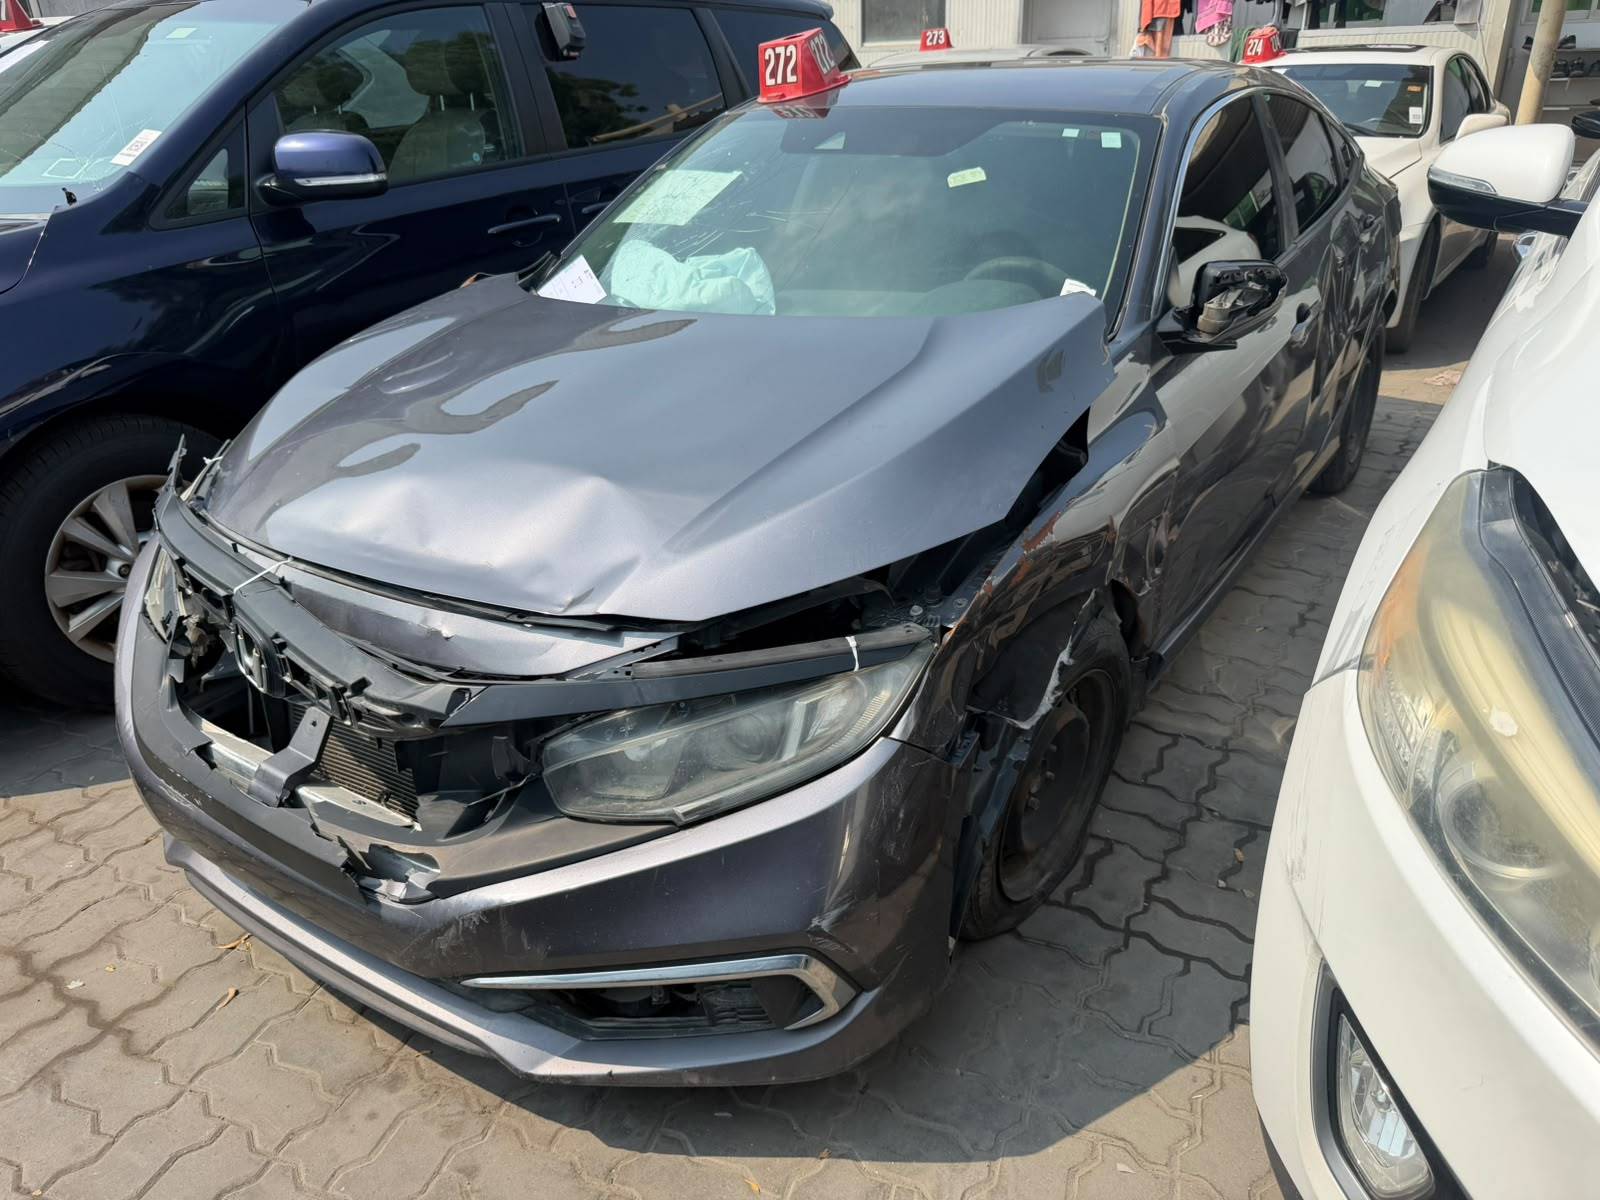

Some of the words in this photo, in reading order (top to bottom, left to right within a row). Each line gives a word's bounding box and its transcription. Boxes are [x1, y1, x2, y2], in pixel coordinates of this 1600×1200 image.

[926, 30, 945, 46] 273
[1247, 38, 1264, 56] 274
[765, 45, 798, 86] 272
